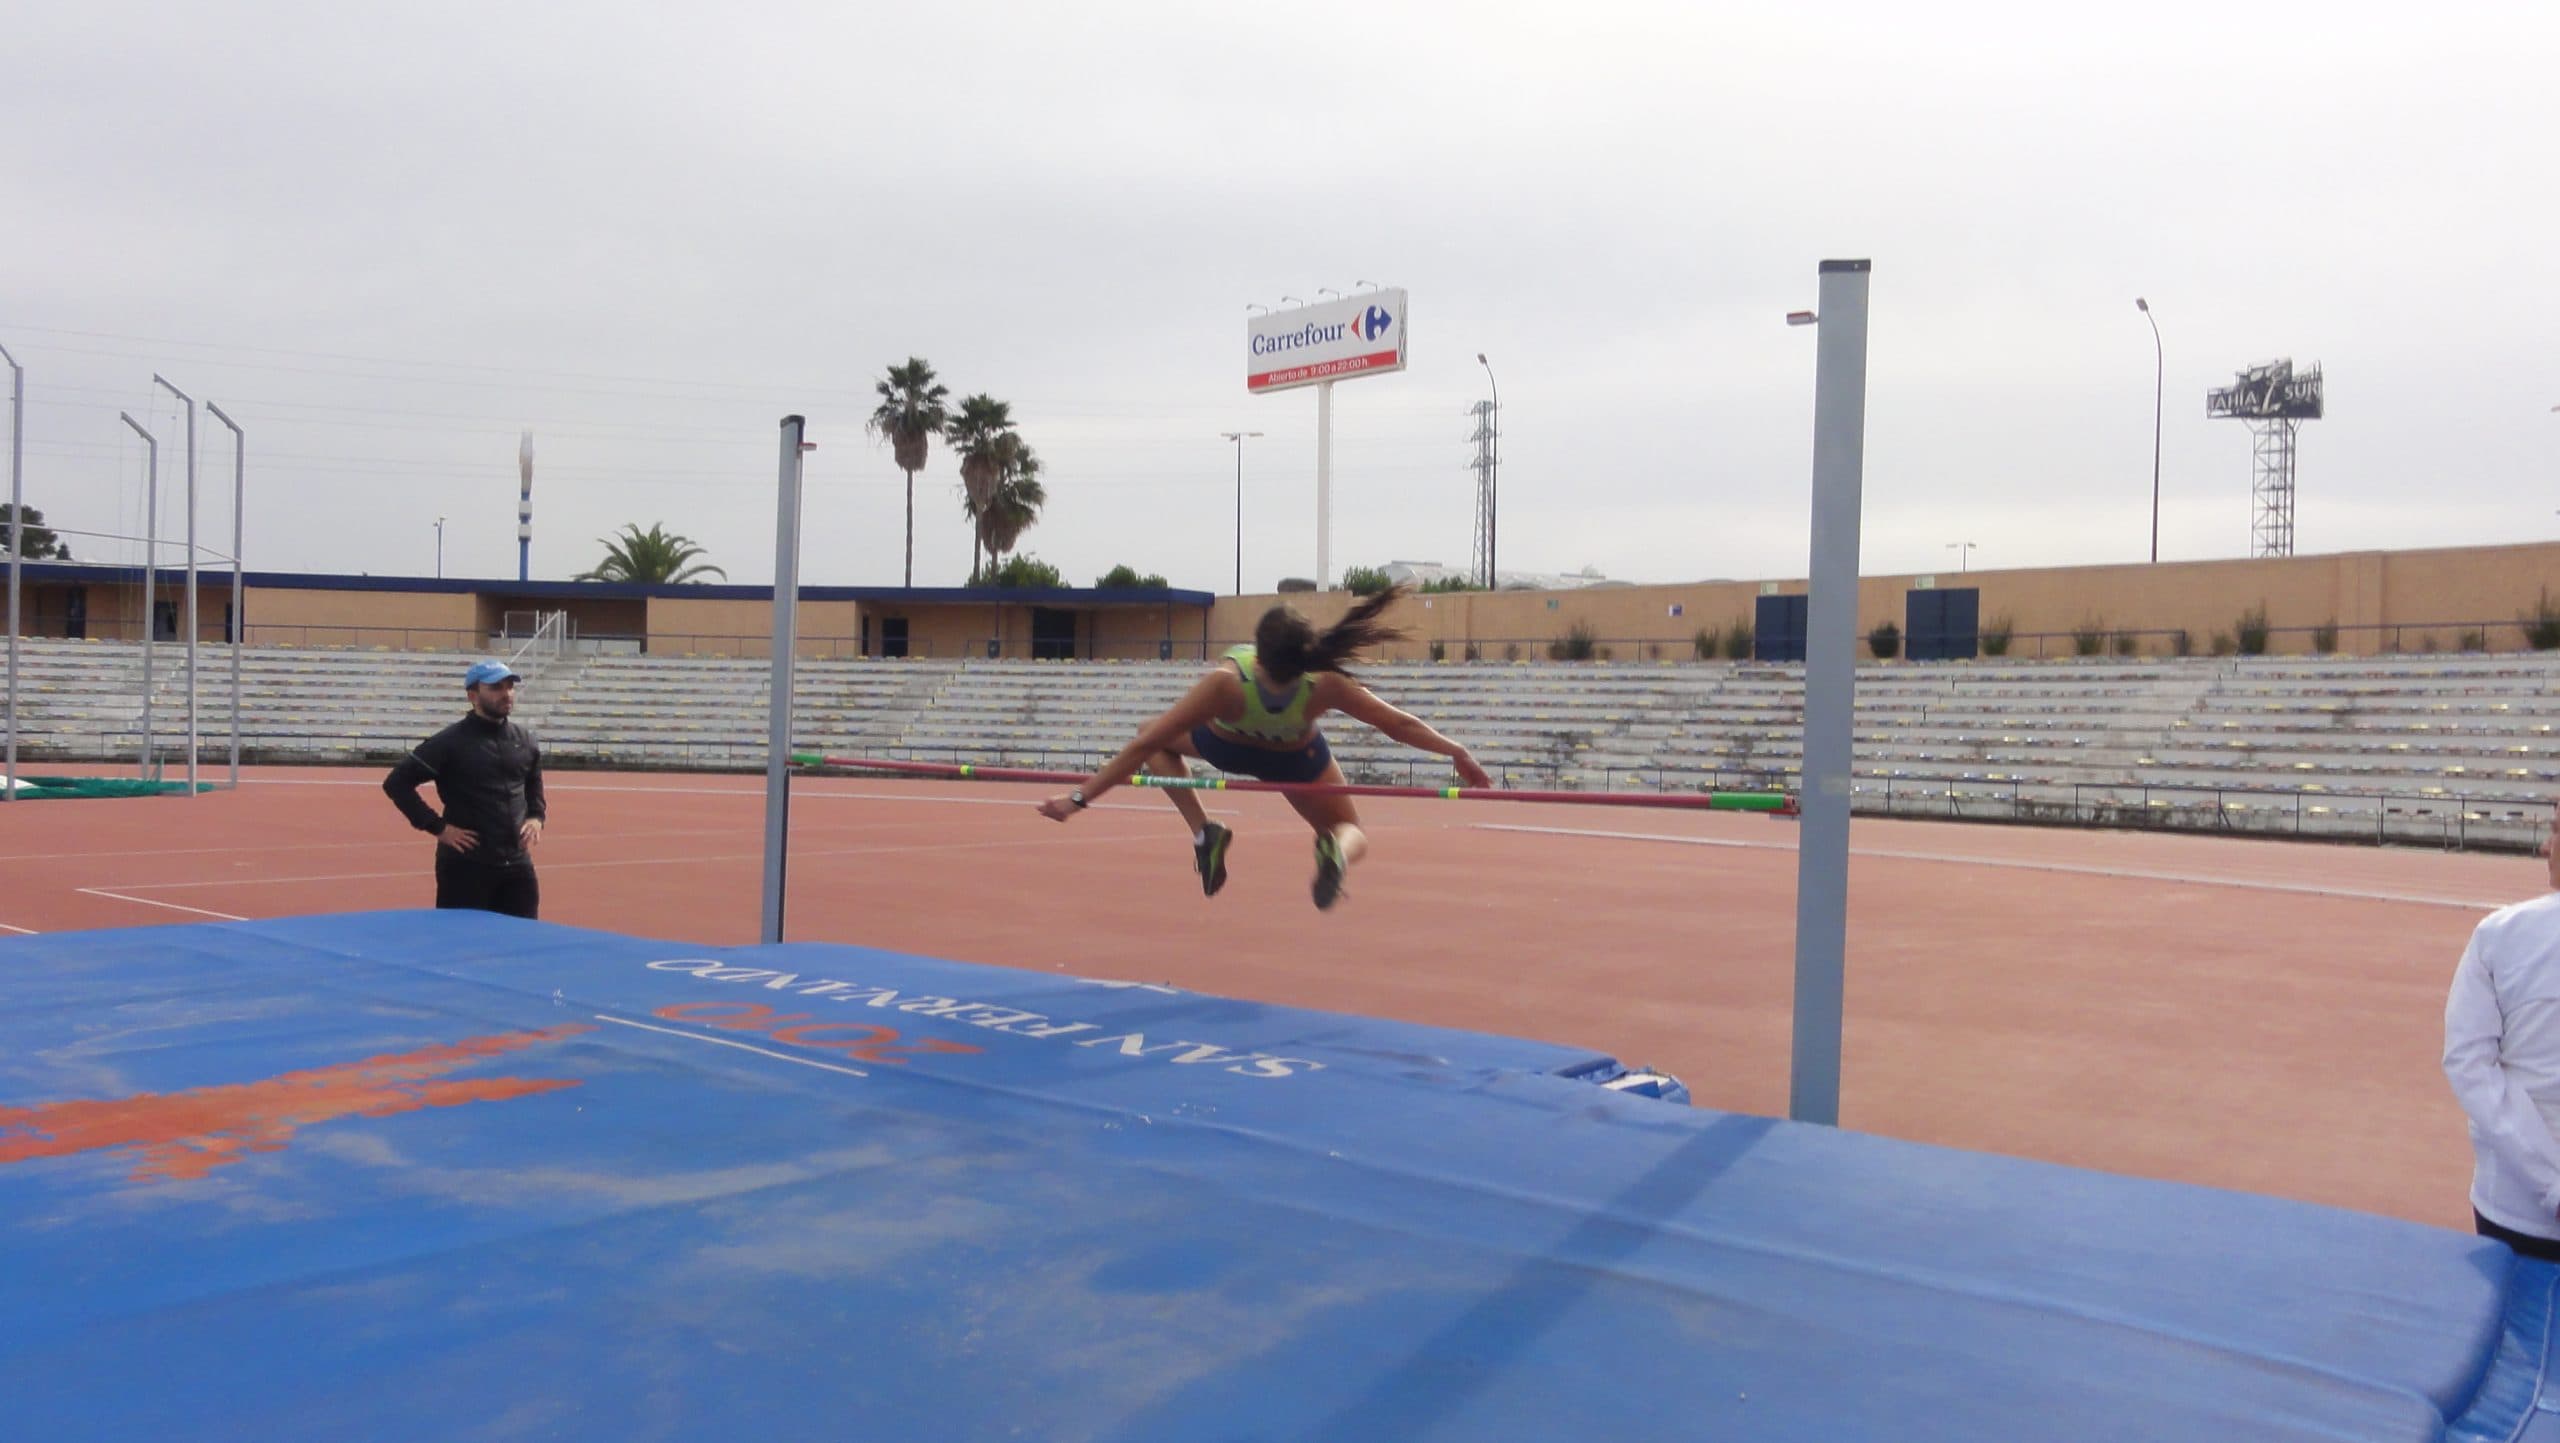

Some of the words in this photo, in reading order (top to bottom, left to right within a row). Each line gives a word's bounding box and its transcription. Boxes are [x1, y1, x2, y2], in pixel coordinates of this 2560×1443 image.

[1252, 321, 1345, 356] Carrefour
[1268, 370, 1297, 385] Abierto
[1297, 368, 1308, 378] de
[645, 958, 1101, 1039] FERNANDO
[652, 1001, 985, 1064] 2010
[1072, 1032, 1327, 1078] SAN
